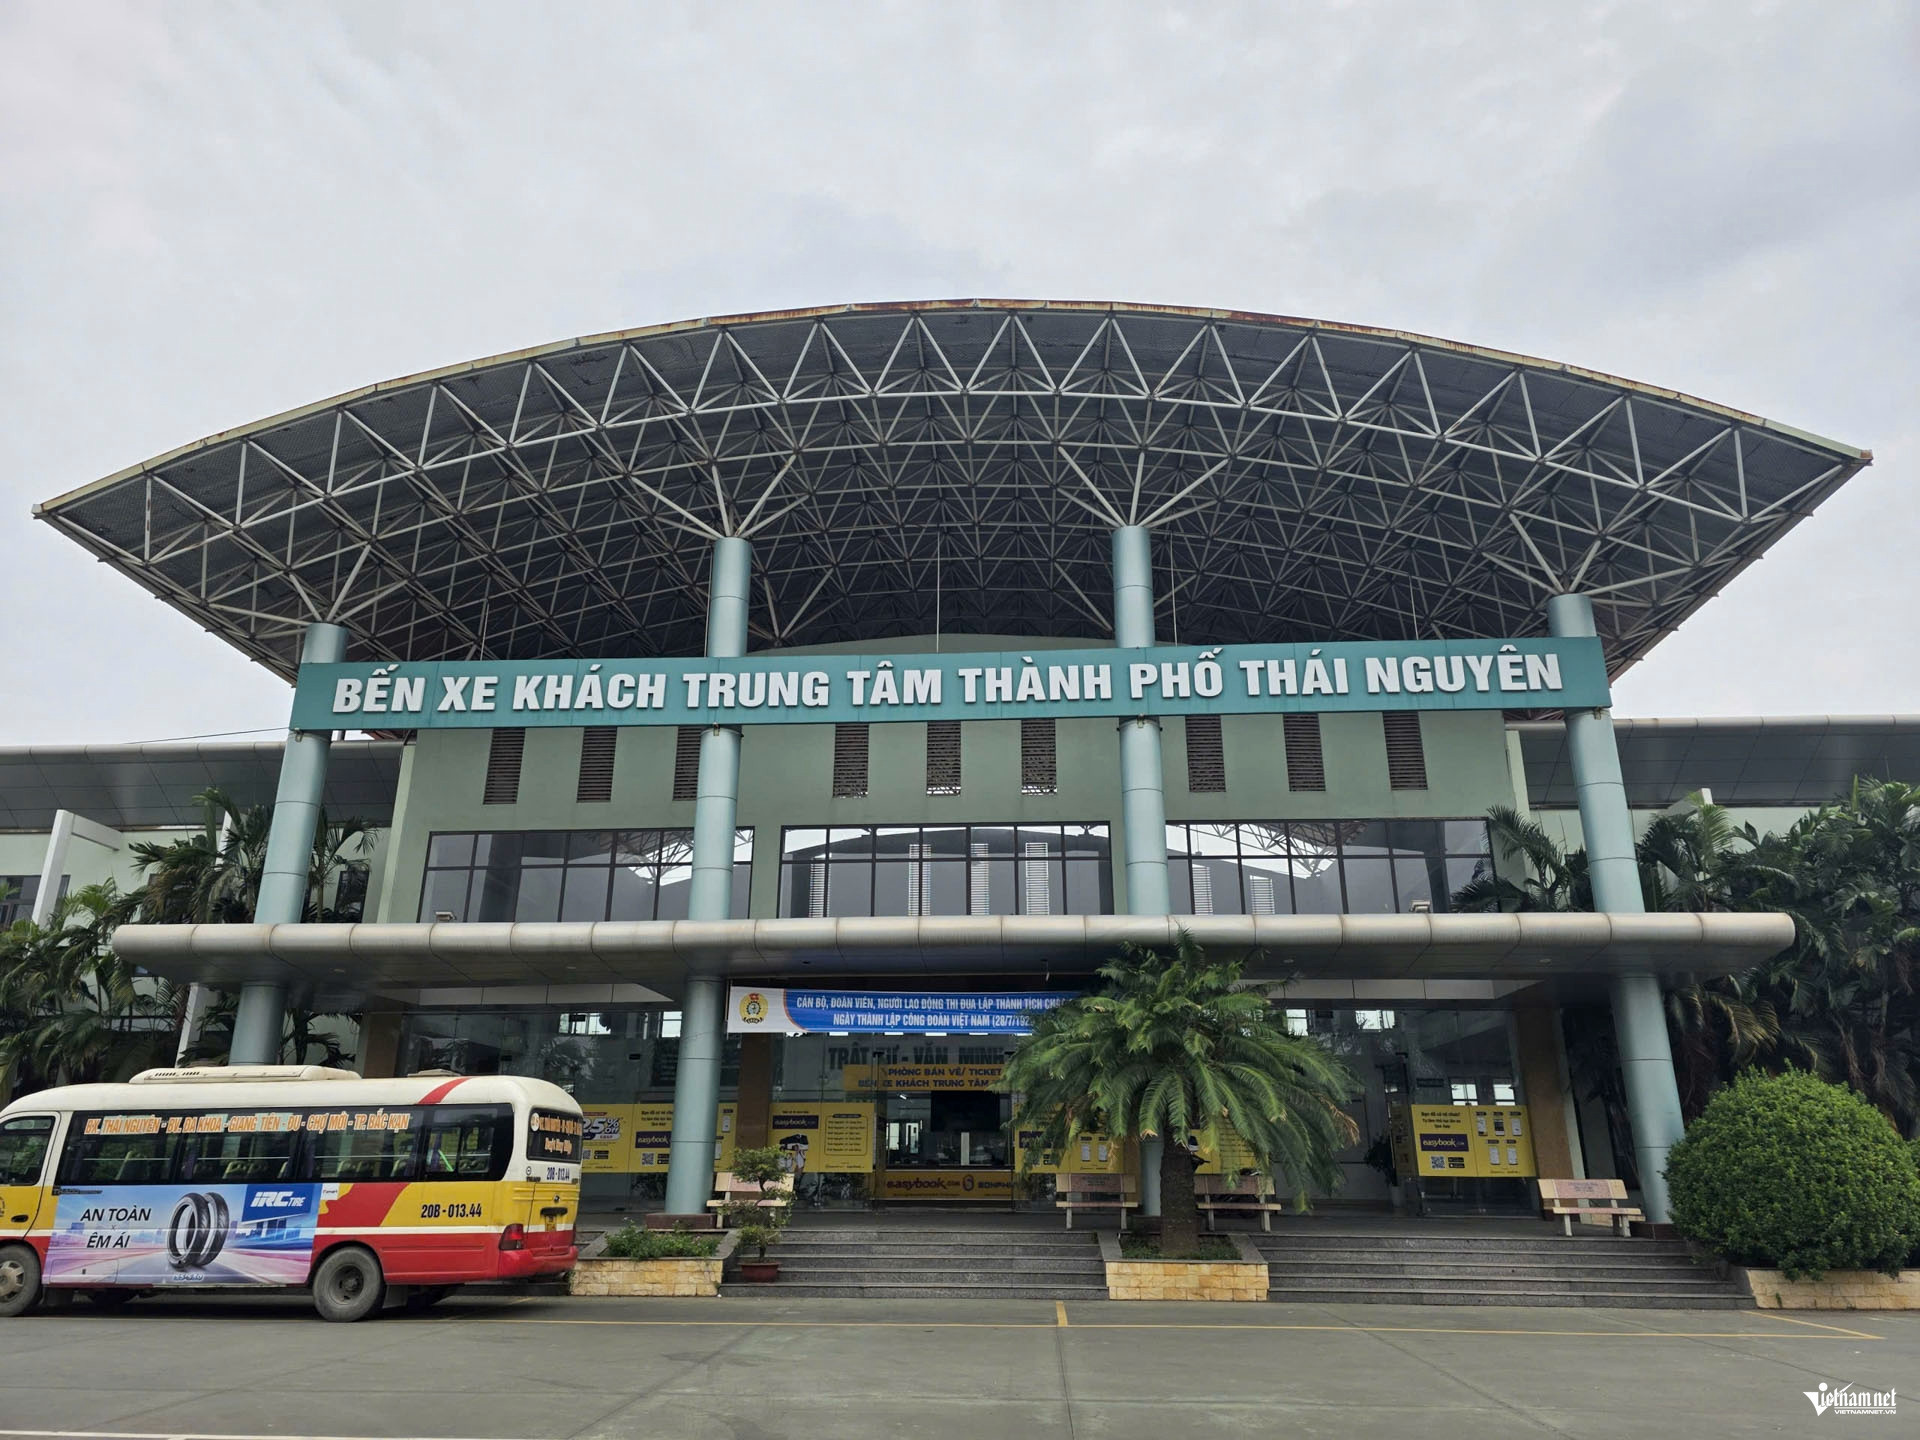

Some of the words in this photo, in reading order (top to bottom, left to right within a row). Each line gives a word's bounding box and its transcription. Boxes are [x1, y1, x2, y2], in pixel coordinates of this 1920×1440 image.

[331, 663, 426, 714] BẾN
[437, 675, 499, 712] XE
[512, 663, 667, 712] KHÁCH
[682, 671, 830, 709] TRUNG
[847, 660, 942, 707] TÂM
[958, 656, 1113, 704] THÀNH
[1128, 647, 1223, 699] PHỐ
[1239, 648, 1349, 697] THÁI
[1364, 644, 1563, 694] NGUYÊN
[796, 996, 814, 1008] CÁN
[830, 996, 853, 1009] ĐOÀN
[877, 996, 902, 1009] NGƯỜI
[904, 998, 919, 1010] LAO
[921, 997, 943, 1011] ĐỘNG
[945, 998, 958, 1010] THI
[960, 998, 976, 1010] ĐUA
[978, 996, 993, 1012] LẬP
[995, 996, 1022, 1010] THÀNH
[1023, 996, 1043, 1010] TÍCH
[833, 1012, 855, 1026] NGÀY
[856, 1012, 883, 1026] THÀNH
[885, 1013, 900, 1028] LẬP
[902, 1012, 925, 1027] CÔNG
[927, 1012, 949, 1027] ĐOÀN
[951, 1012, 969, 1029] VIỆT
[971, 1014, 989, 1027] NAM
[913, 1042, 948, 1065] VĂN
[888, 1066, 921, 1076] PHÒNG
[968, 1068, 1002, 1076] TICKET
[895, 1078, 929, 1087] KHÁCH
[968, 1078, 989, 1087] TÂM
[100, 1115, 124, 1135] THÁI
[124, 1114, 162, 1135] NGUYÊN
[197, 1116, 223, 1133] KHOA
[227, 1115, 258, 1133] GIANG
[306, 1113, 330, 1134] CHỢ
[388, 1113, 410, 1133] KẠN
[80, 1208, 104, 1221] AN
[108, 1205, 152, 1221] TOÀN
[86, 1232, 111, 1248] ÊM
[113, 1232, 130, 1248] ÁI
